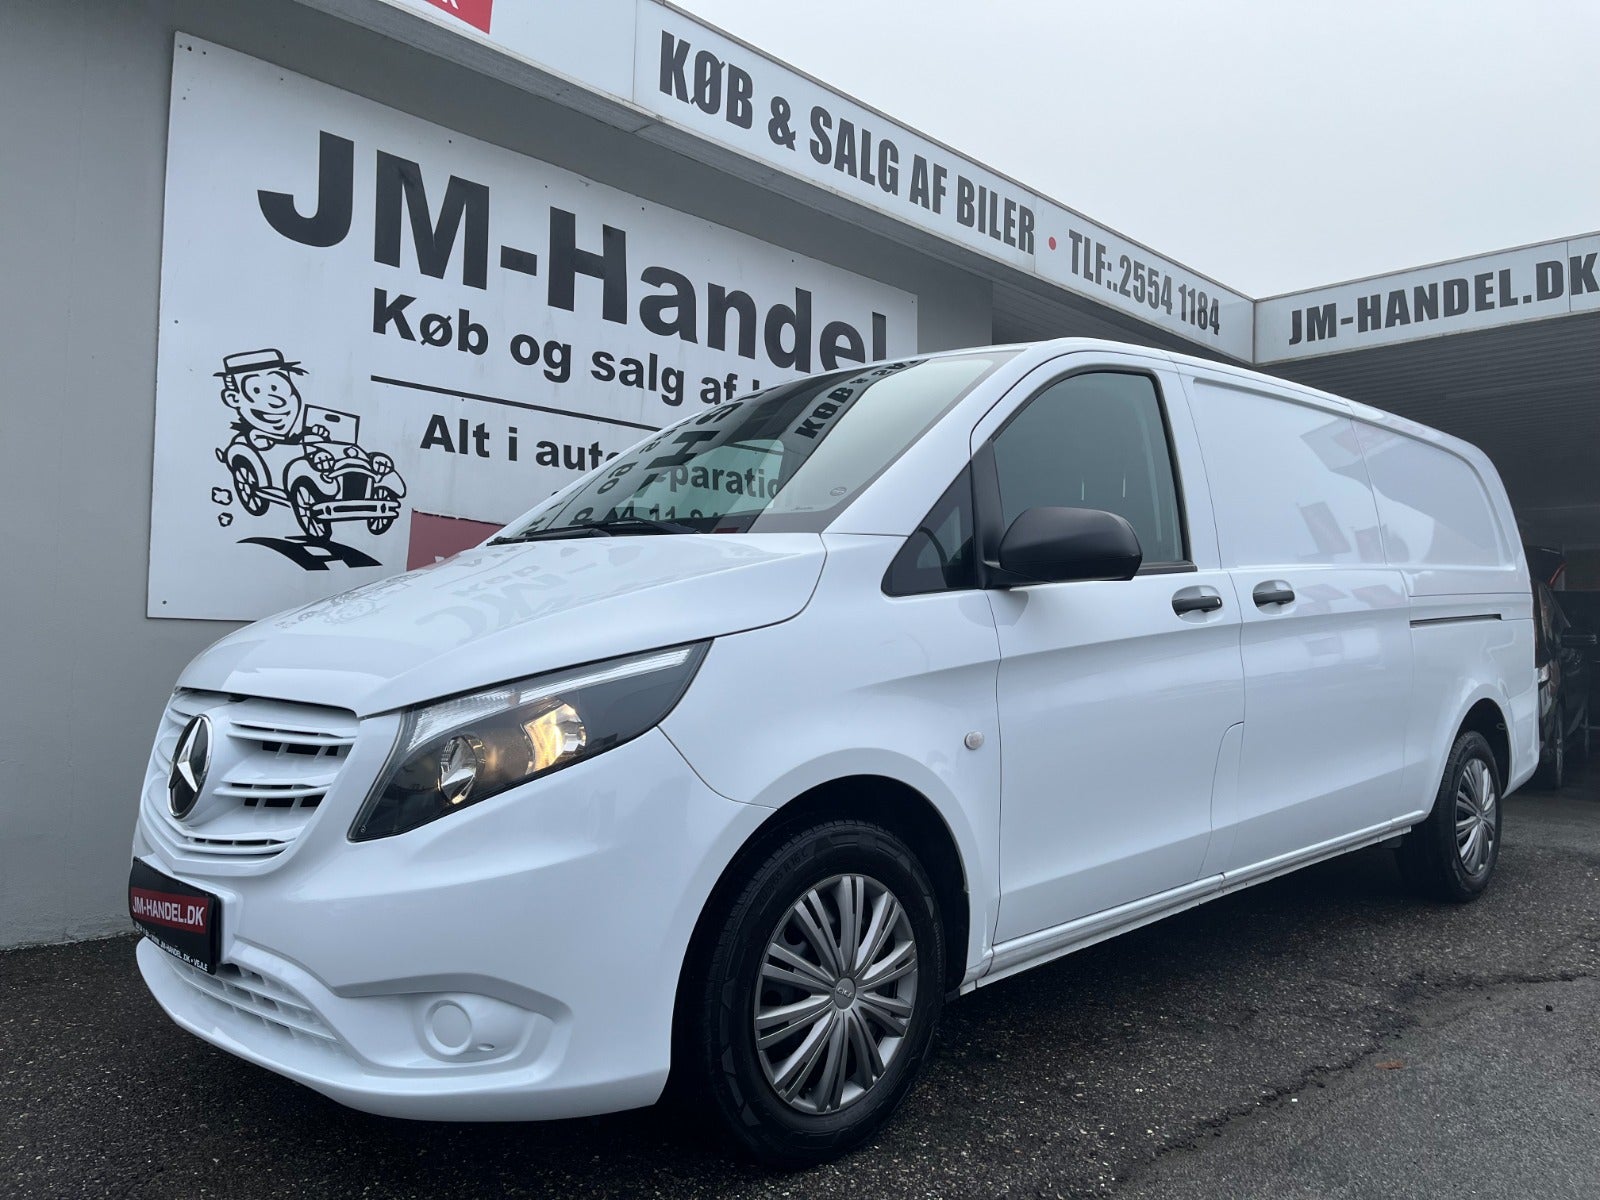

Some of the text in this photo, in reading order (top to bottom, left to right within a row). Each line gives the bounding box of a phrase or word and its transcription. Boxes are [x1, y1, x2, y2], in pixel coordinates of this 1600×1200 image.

[659, 30, 1035, 255] KØB & SALG AF BILER
[257, 130, 887, 374] JM-Handel
[1288, 252, 1600, 346] JM-HANDEL.DK
[372, 287, 738, 407] Køb og salg af
[1178, 283, 1220, 336] 1184
[420, 414, 490, 459] Alt
[508, 426, 518, 462] i
[132, 896, 205, 926] JM-HANDEL.DK
